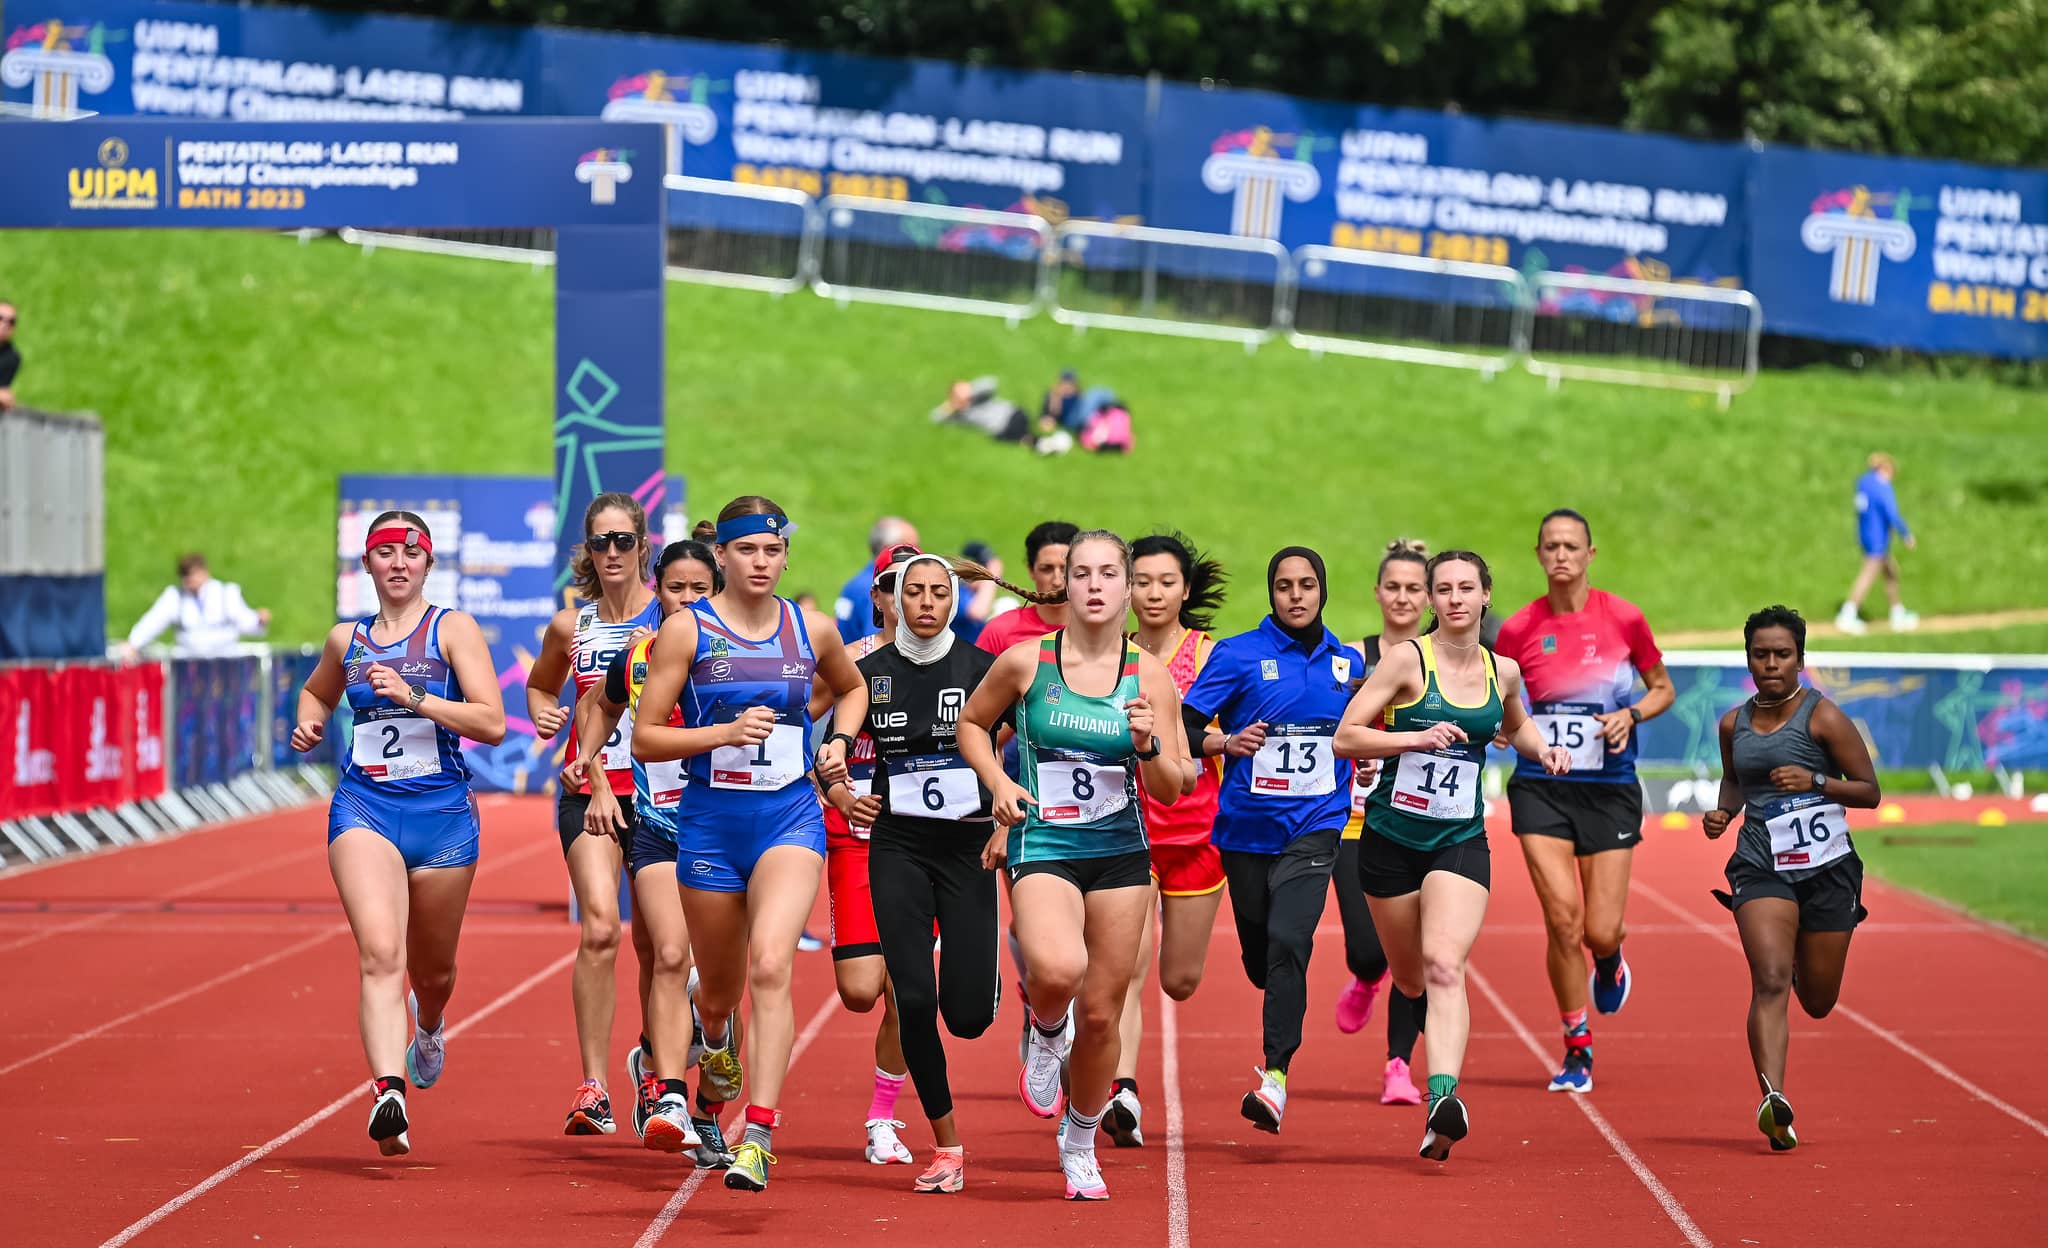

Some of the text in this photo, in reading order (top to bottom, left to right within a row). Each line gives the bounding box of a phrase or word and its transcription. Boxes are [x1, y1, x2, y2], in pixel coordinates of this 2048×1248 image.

[134, 19, 218, 54] UIPM
[131, 82, 228, 118] World
[449, 75, 523, 111] RUN
[406, 142, 458, 163] RUN
[733, 131, 1064, 194] World Championships
[1048, 127, 1123, 165] RUN
[69, 168, 157, 198] UIPM
[178, 160, 418, 189] World Championships
[179, 187, 305, 208] BATH 2023
[1653, 188, 1728, 227] RUN
[1940, 185, 2021, 222] UIPM
[1335, 190, 1668, 254] World Championships
[1933, 246, 2028, 287] World
[1928, 280, 2016, 320] BATH
[1049, 710, 1120, 737] LITHUANIA
[1548, 720, 1584, 749] 15
[381, 725, 404, 759] 2
[750, 738, 772, 766] 1
[1274, 742, 1318, 774] 13
[922, 776, 945, 811] 6
[1071, 767, 1095, 801] 8
[1417, 761, 1459, 797] 14
[1789, 812, 1830, 849] 16
